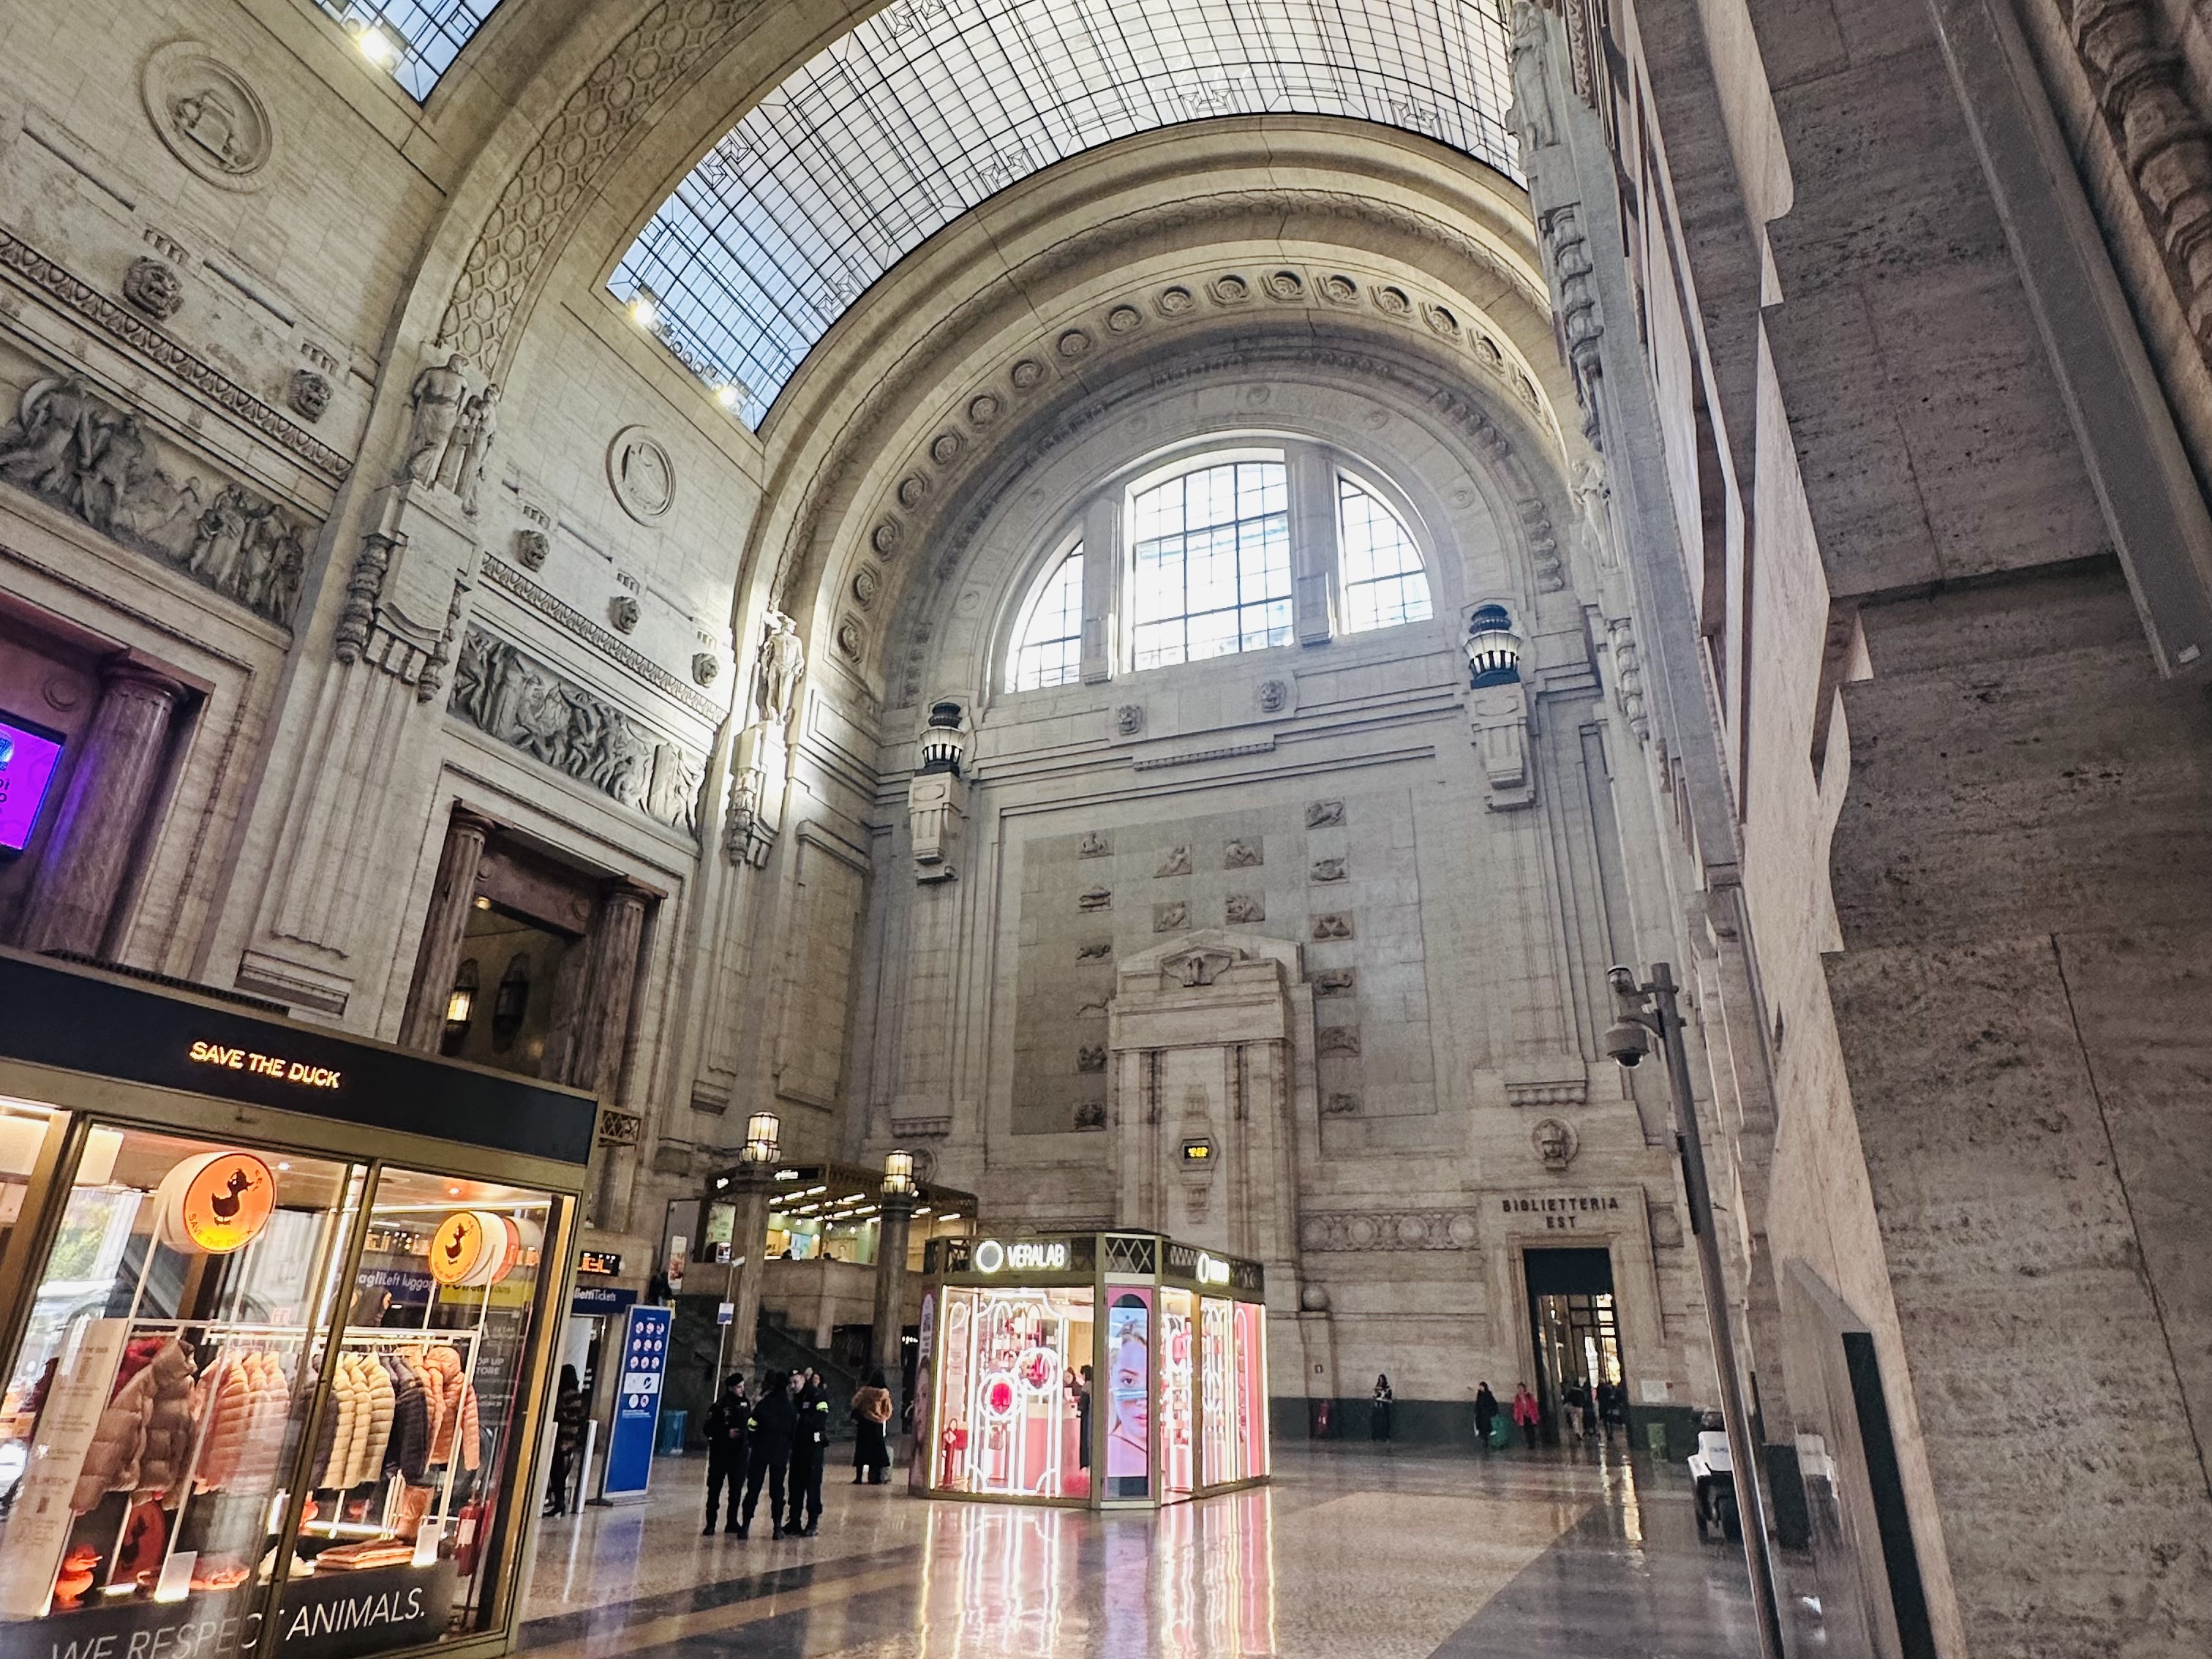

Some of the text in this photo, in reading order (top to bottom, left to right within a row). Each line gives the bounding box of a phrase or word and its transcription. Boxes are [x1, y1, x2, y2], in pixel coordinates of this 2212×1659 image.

[189, 1040, 342, 1089] SAVE THE DUCK
[1502, 1197, 1619, 1213] BIGLIETTERIA
[188, 1212, 254, 1248] SAVE THE DUCK
[1546, 1216, 1576, 1229] EST
[1007, 1244, 1065, 1268] VERALAB
[127, 1609, 284, 1659] RESPEC
[286, 1587, 426, 1640] ANIMALS.
